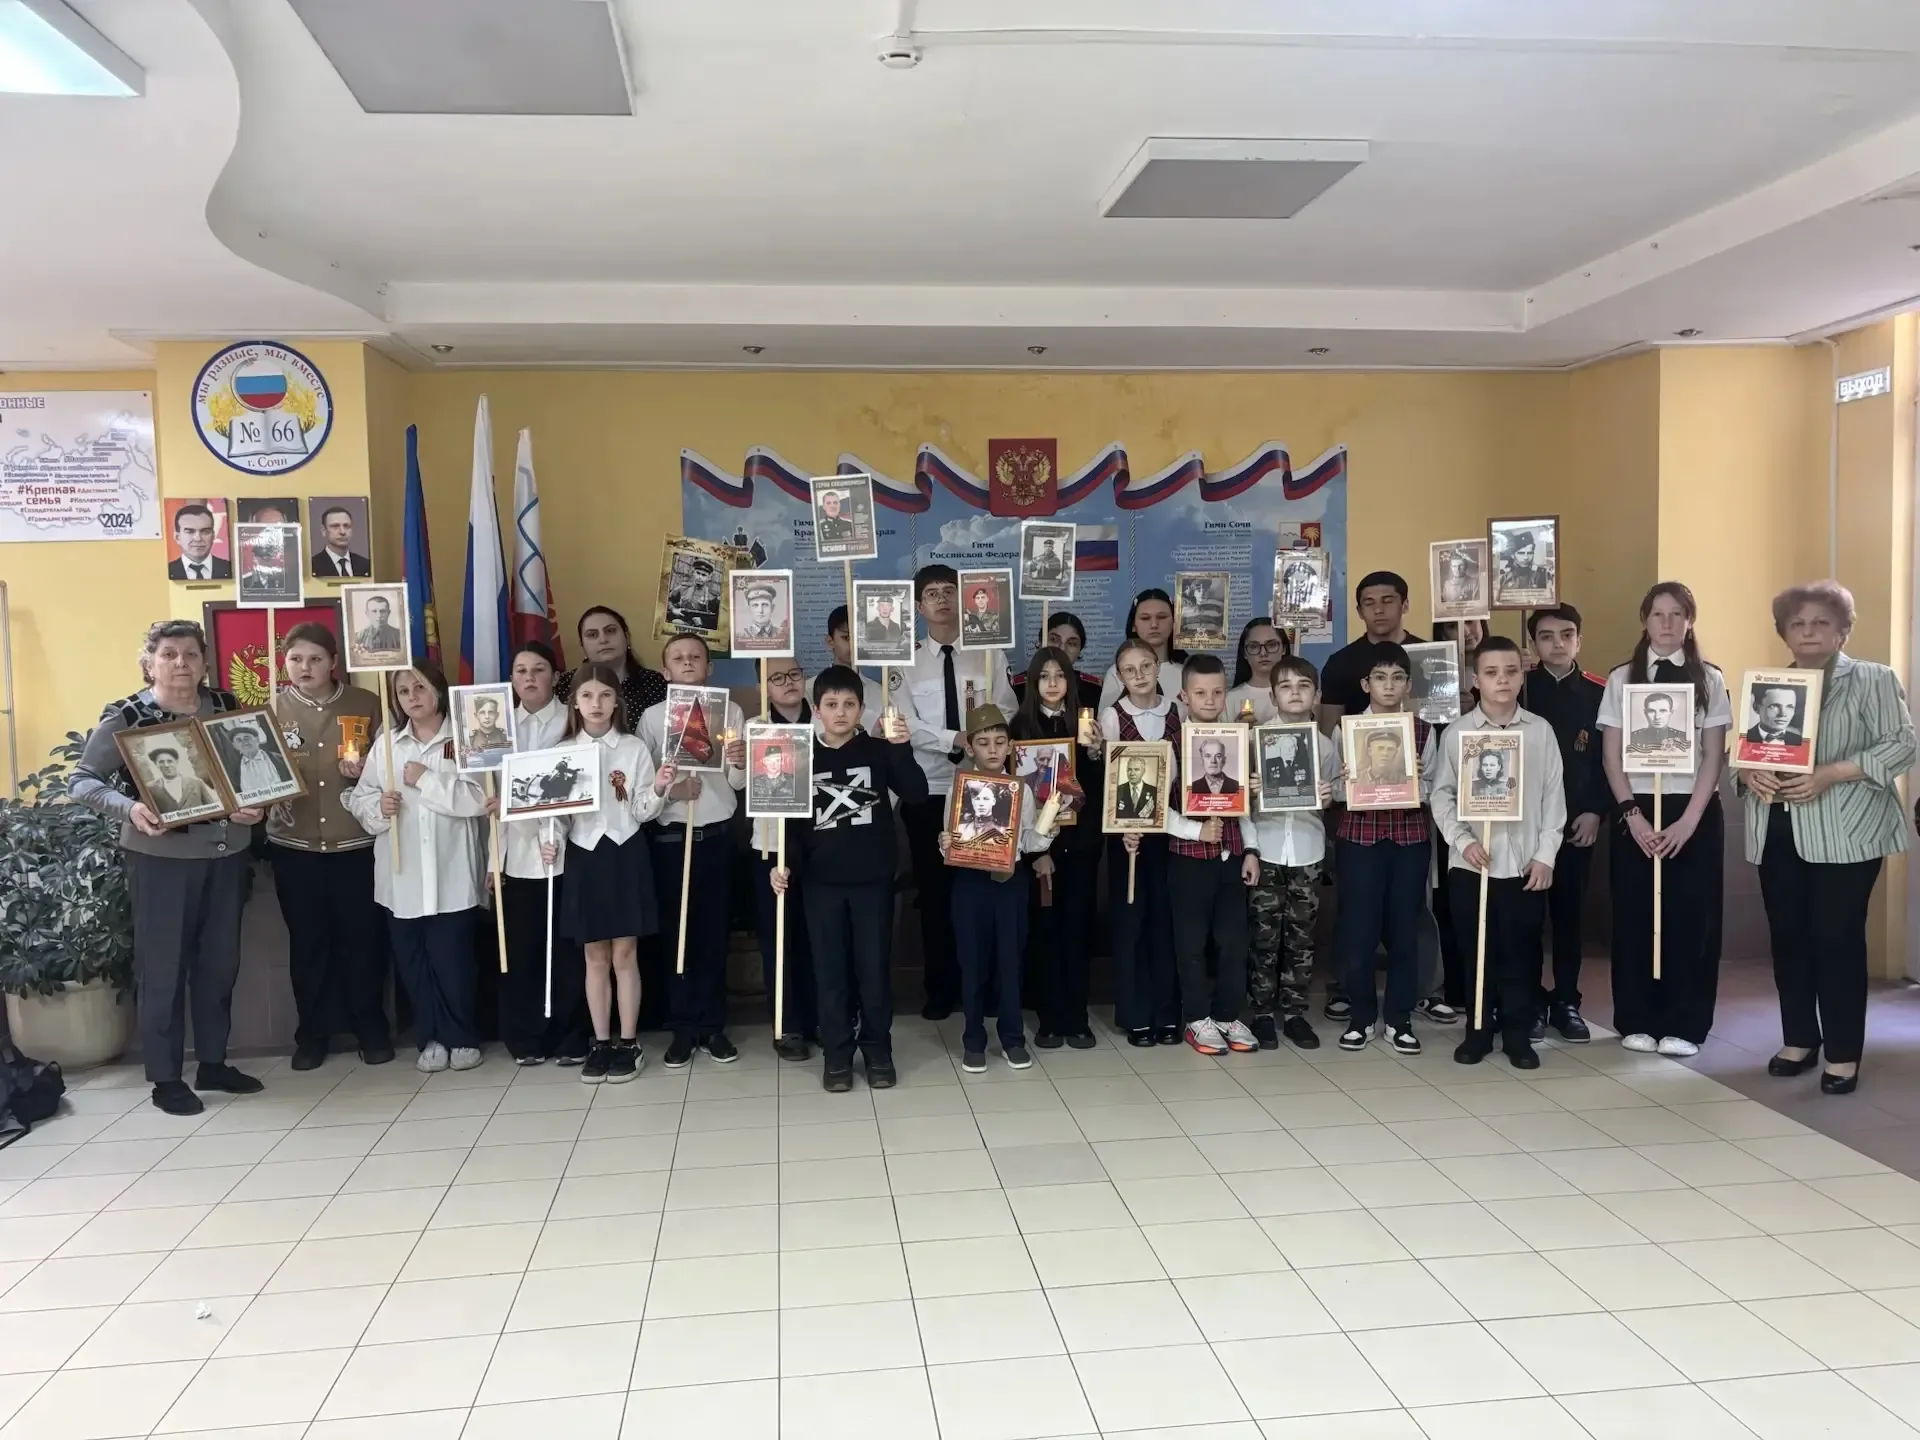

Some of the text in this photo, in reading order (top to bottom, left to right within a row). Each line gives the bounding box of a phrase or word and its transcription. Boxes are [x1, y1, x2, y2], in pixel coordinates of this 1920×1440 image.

[207, 348, 259, 382] разные,
[291, 358, 325, 400] вместе
[1840, 373, 1884, 397] ВЫХОД
[271, 419, 295, 443] 66
[257, 456, 288, 468] Сочи
[17, 485, 77, 497] #Крепкая
[26, 497, 62, 505] семья
[103, 513, 133, 528] 2024
[1204, 521, 1252, 529] Гимн Сочи
[930, 551, 1020, 560] Российской Федера
